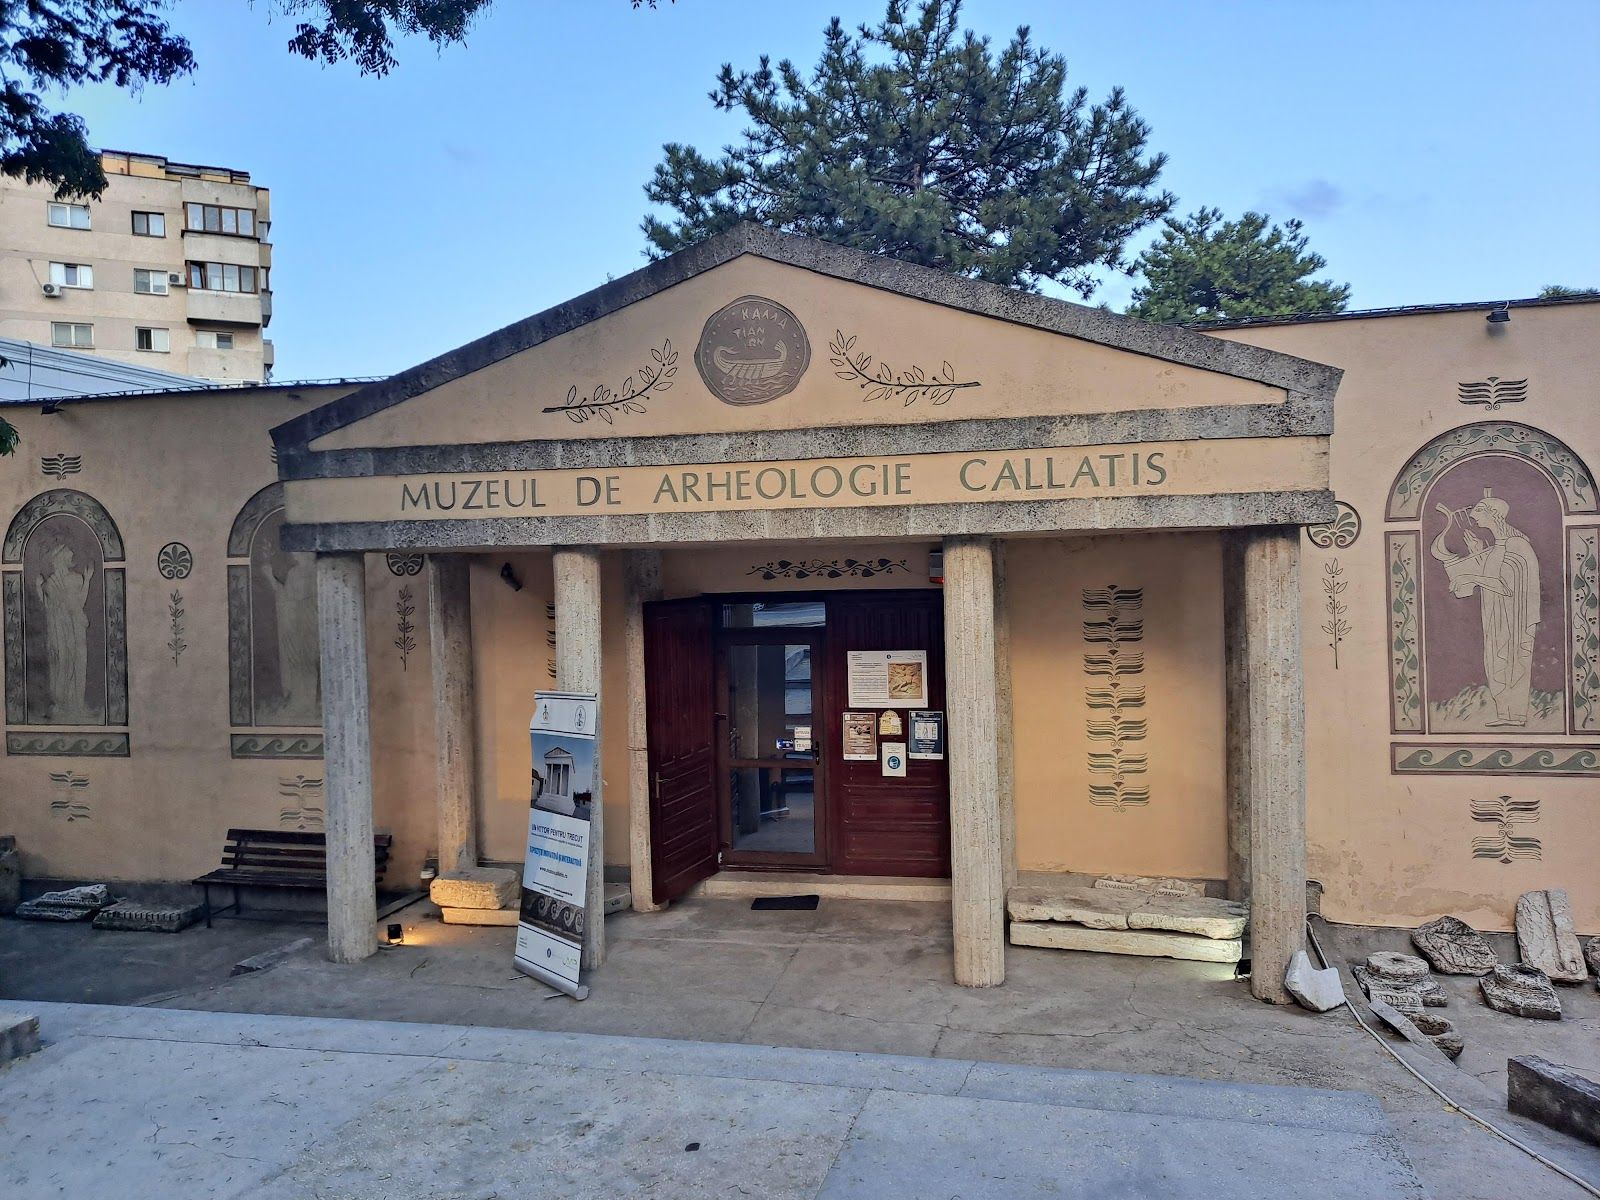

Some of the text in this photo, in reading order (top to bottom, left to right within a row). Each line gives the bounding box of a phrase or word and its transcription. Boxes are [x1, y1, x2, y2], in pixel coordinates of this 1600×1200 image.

[400, 452, 1168, 512] MUZEUL DE ARHEOLOGIE CALLATIS
[550, 828, 566, 838] PENTRU
[567, 832, 583, 843] TRECUT
